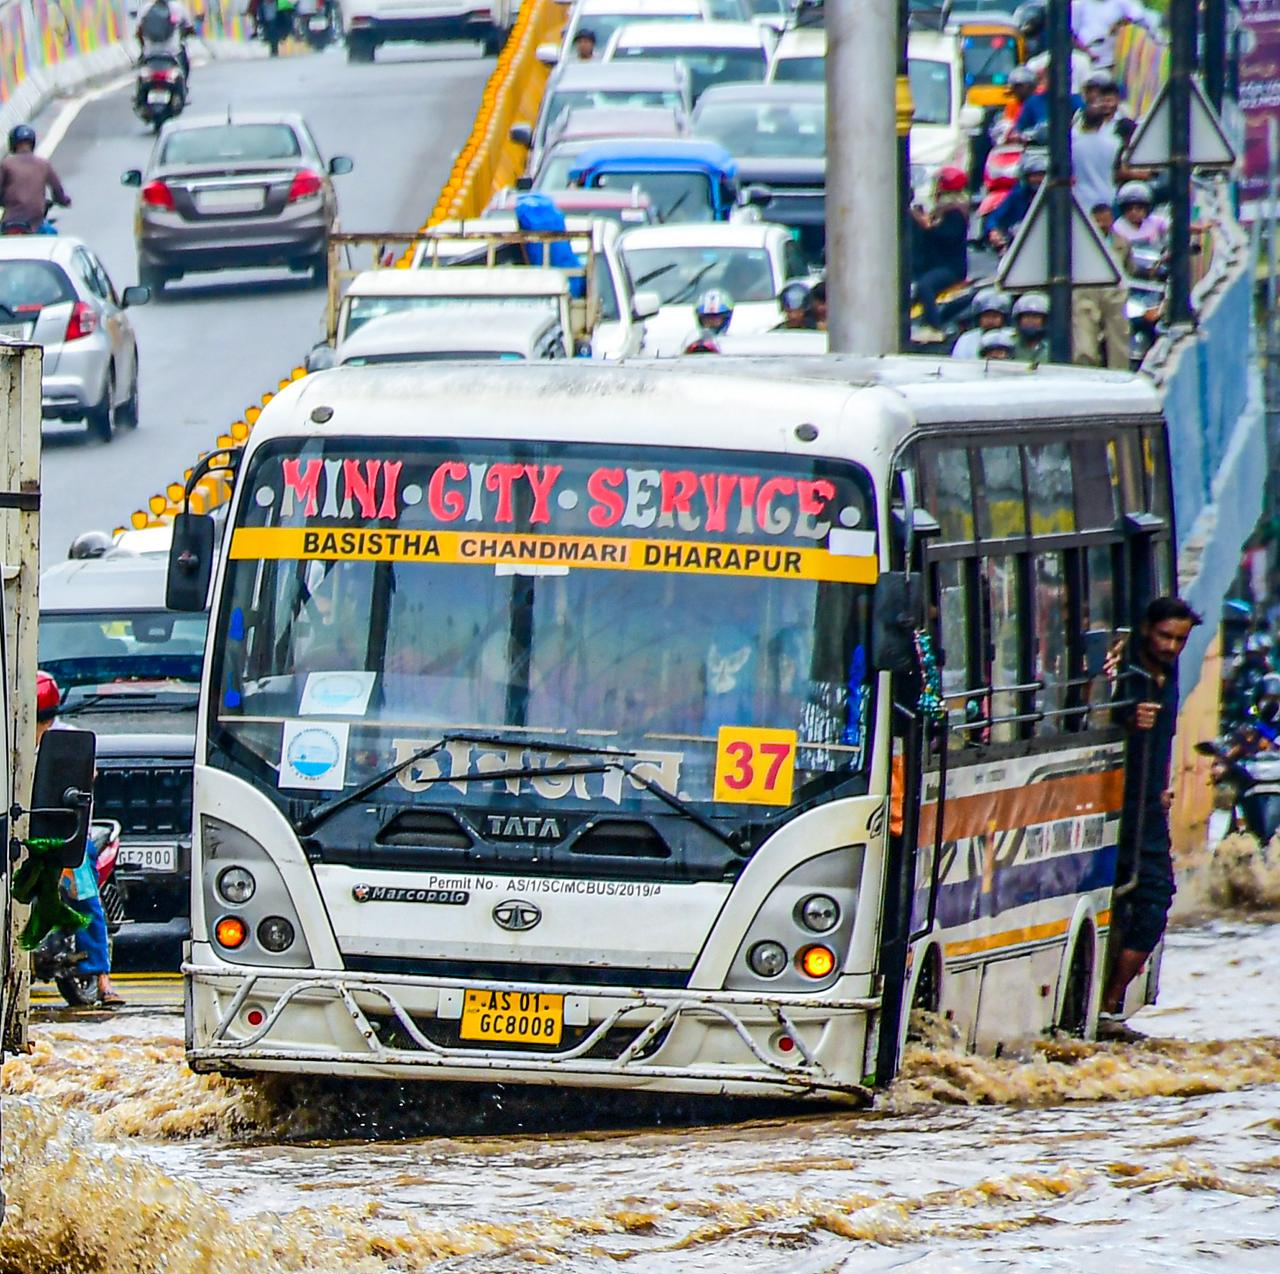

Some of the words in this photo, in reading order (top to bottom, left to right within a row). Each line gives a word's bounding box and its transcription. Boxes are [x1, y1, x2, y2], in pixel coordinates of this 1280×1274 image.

[280, 458, 403, 520] MINI
[428, 460, 563, 524] CITY
[587, 466, 836, 540] SERVICE
[303, 532, 440, 556] BASISTHA
[460, 538, 627, 563] CHANDMARI
[643, 544, 802, 573] DHARAPUR
[723, 741, 791, 791] 37
[487, 815, 561, 839] TATA
[428, 876, 472, 890] Permit
[371, 887, 465, 903] Marcopolo
[488, 990, 512, 1011] AS
[520, 993, 541, 1013] 01
[480, 1014, 555, 1036] GC8008
